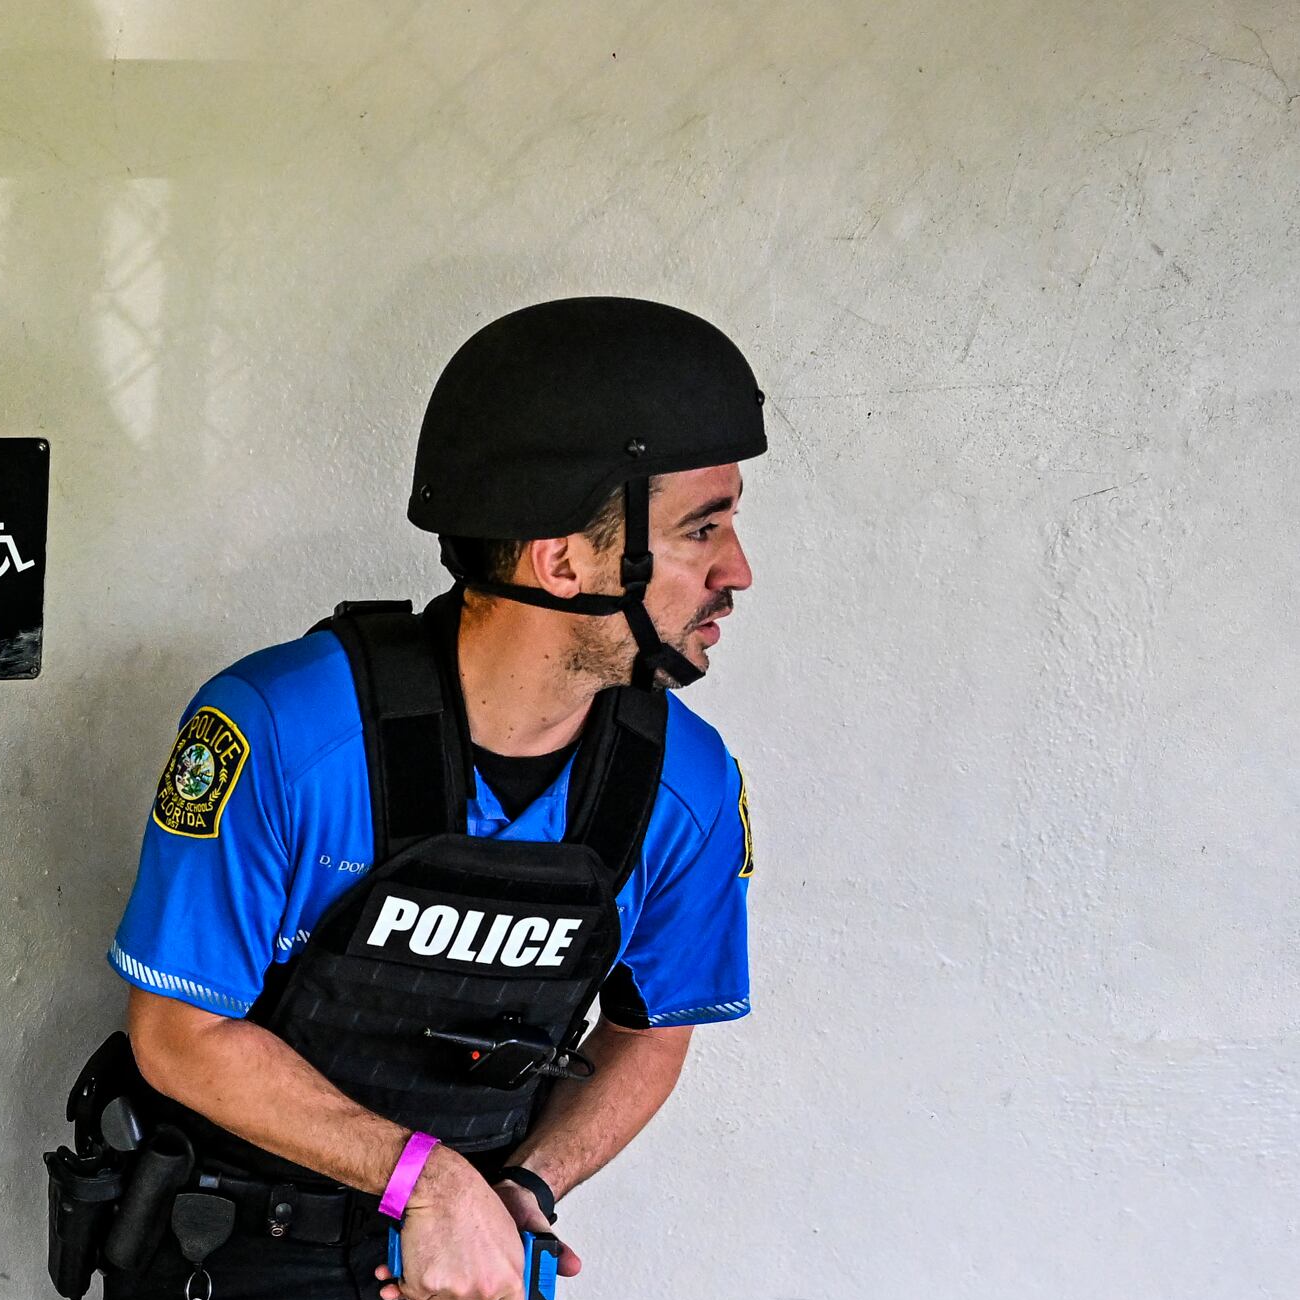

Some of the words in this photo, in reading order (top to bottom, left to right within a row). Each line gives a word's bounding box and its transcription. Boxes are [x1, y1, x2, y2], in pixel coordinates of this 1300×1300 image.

[188, 714, 242, 766] POLICE
[158, 788, 207, 828] FLORIDA
[185, 801, 214, 813] SCHOOLS
[366, 895, 583, 968] POLICE
